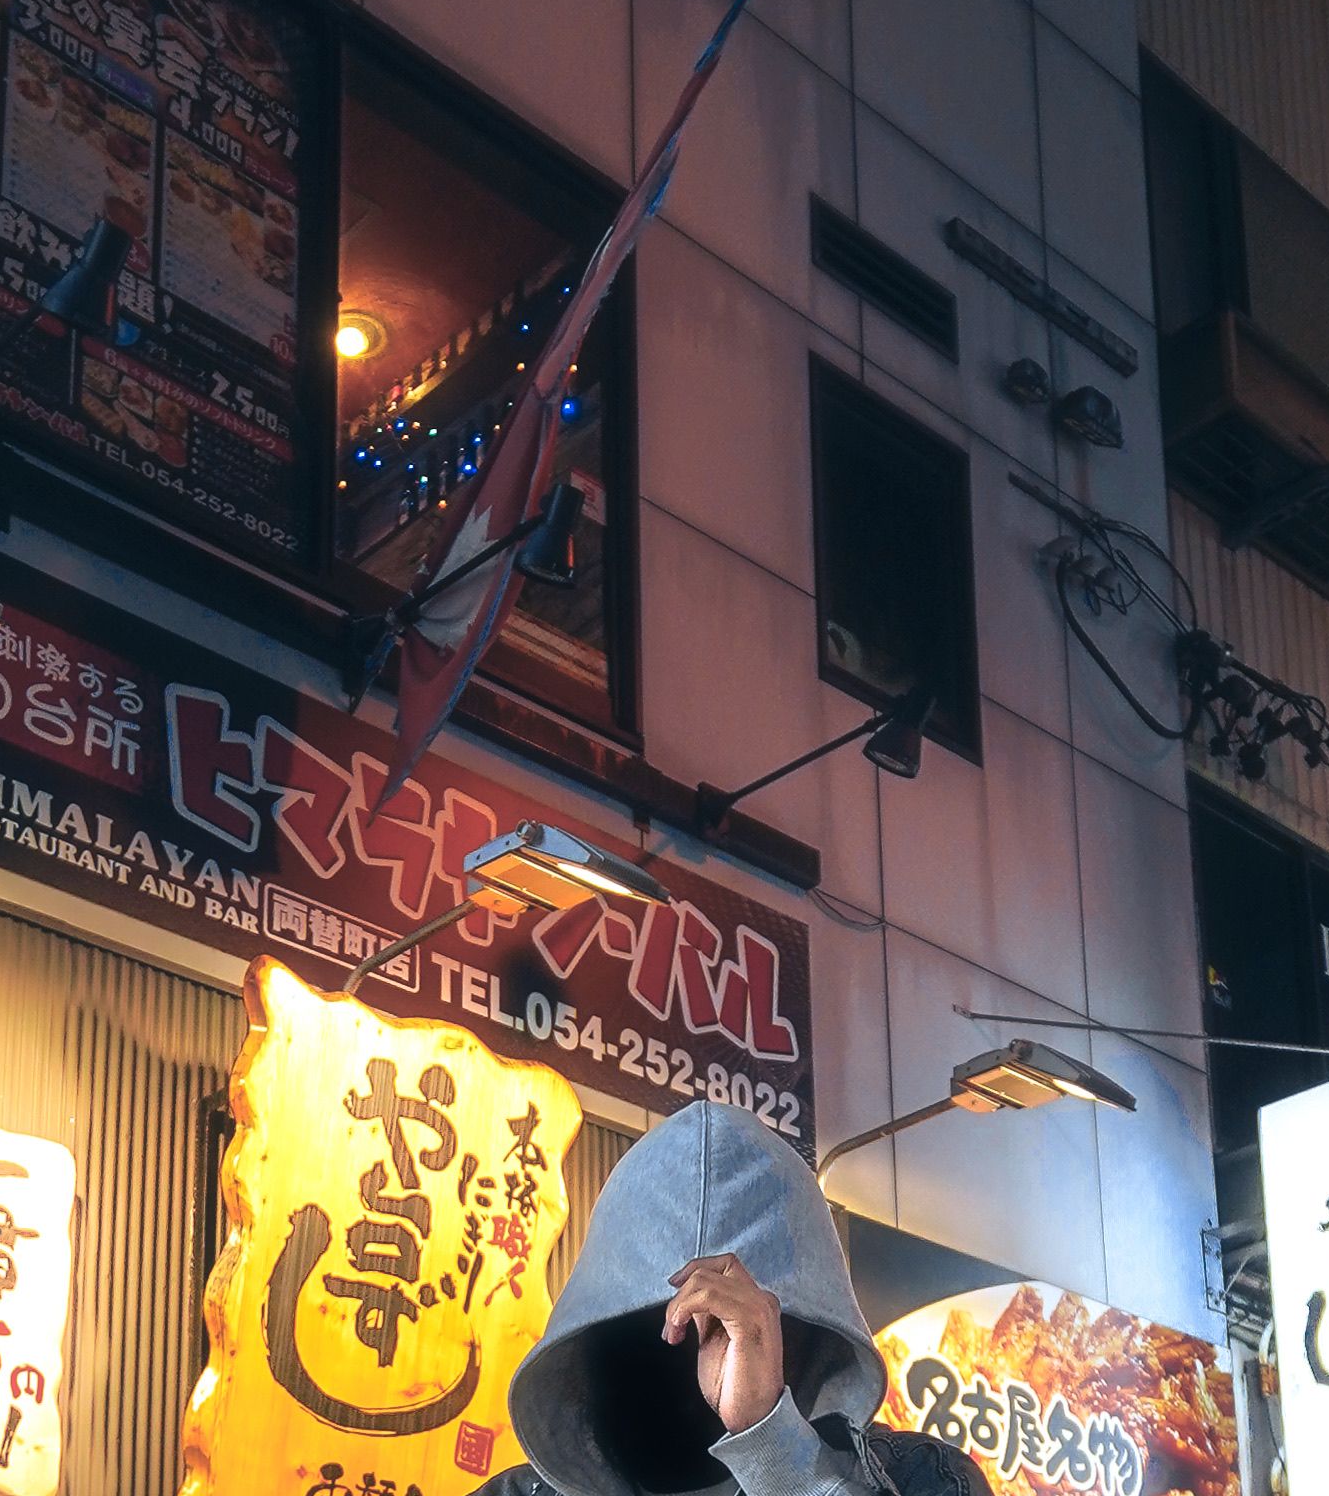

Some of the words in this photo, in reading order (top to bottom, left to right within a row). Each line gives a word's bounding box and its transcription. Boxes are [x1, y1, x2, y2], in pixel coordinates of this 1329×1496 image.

[92, 432, 302, 552] TEL.054-252-8022
[139, 870, 197, 912] AND
[203, 897, 261, 936] BAR
[430, 952, 802, 1138] TEL.054-252-8022
